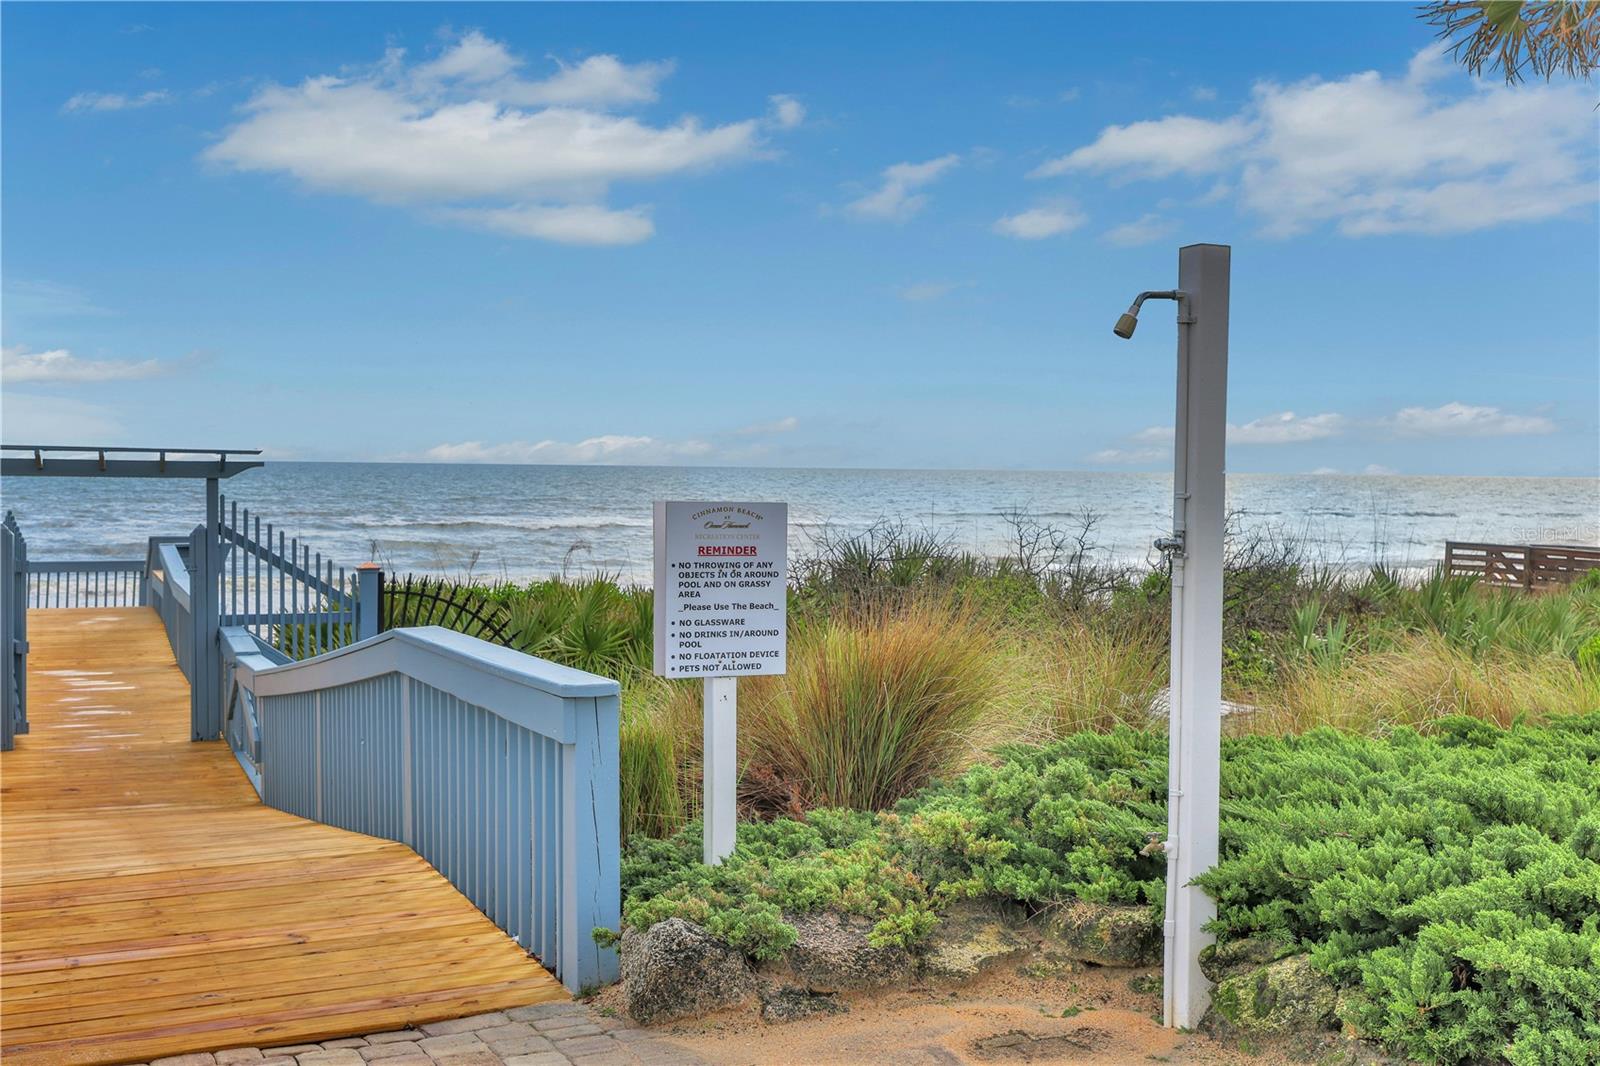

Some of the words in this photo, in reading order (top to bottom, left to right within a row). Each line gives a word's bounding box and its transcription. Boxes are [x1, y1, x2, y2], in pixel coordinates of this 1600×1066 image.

[692, 507, 734, 520] CINNAMON
[698, 546, 757, 556] REMINDER
[730, 630, 779, 638] IN/AROUND
[723, 663, 762, 671] ALLOWED
